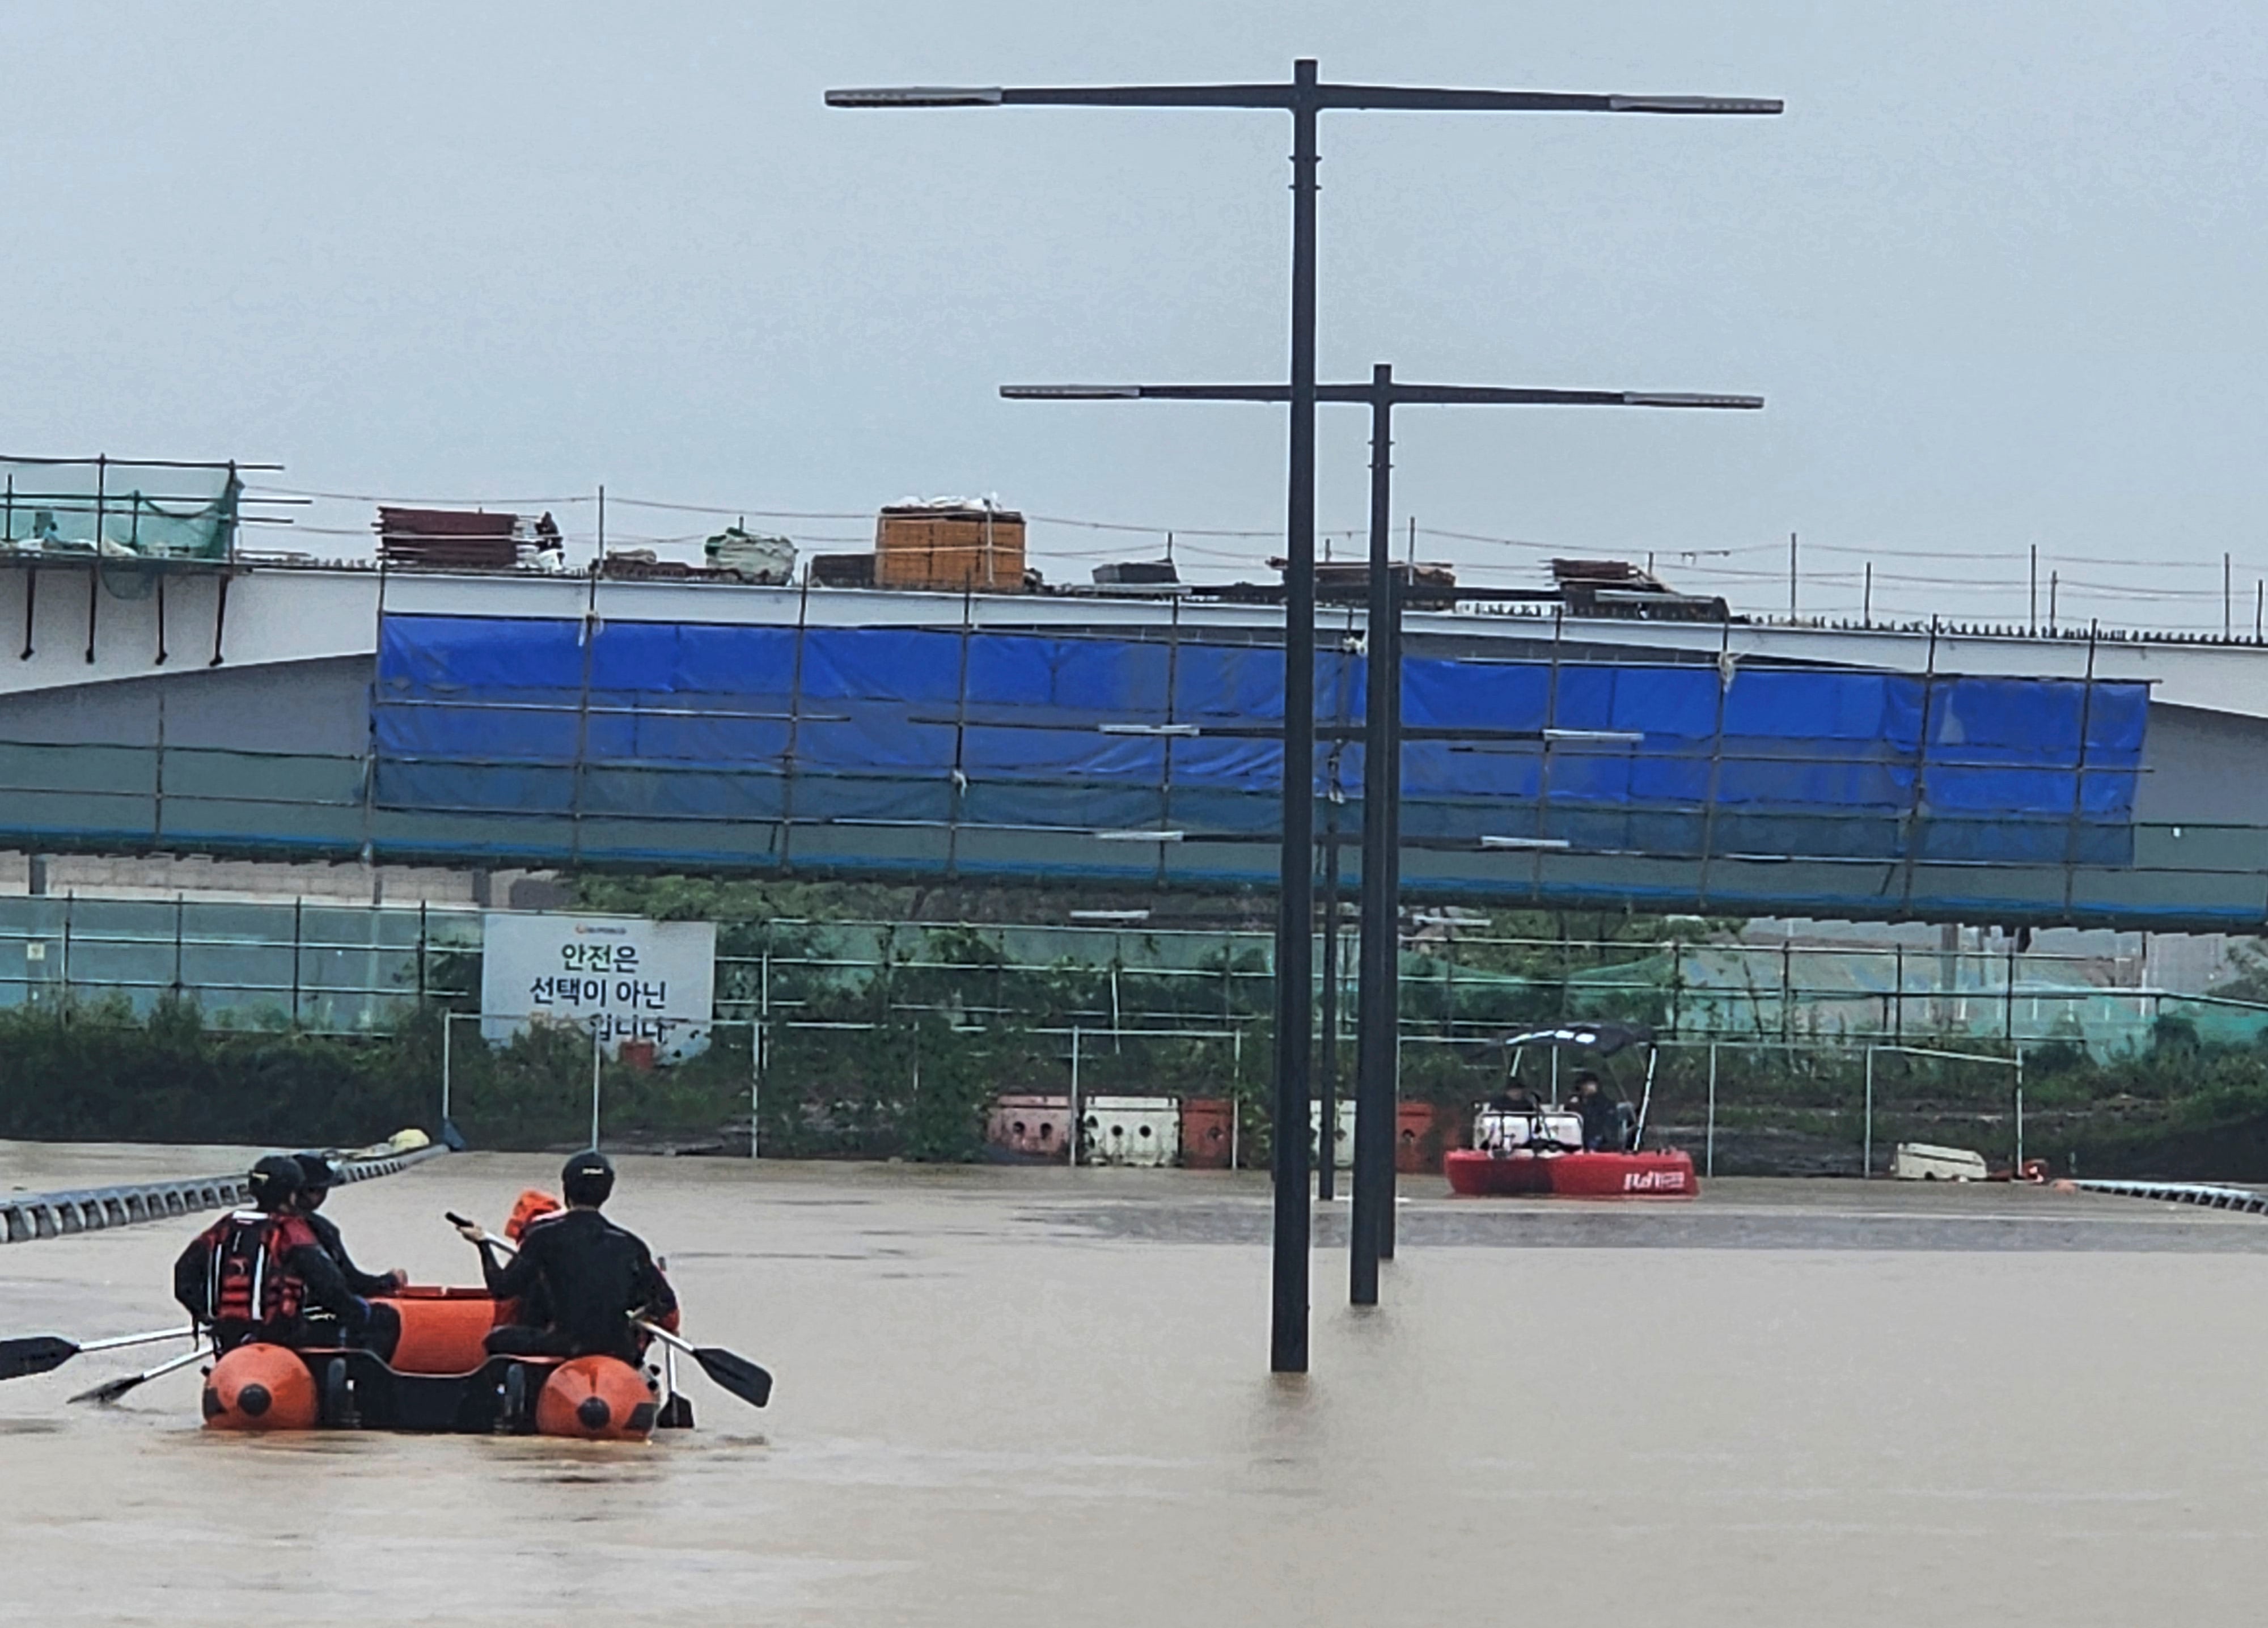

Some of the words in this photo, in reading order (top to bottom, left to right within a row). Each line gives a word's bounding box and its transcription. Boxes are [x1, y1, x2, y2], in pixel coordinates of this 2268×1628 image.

[561, 944, 639, 973] 안전은
[530, 976, 606, 1008] 선택이
[616, 979, 666, 1009] 아닌
